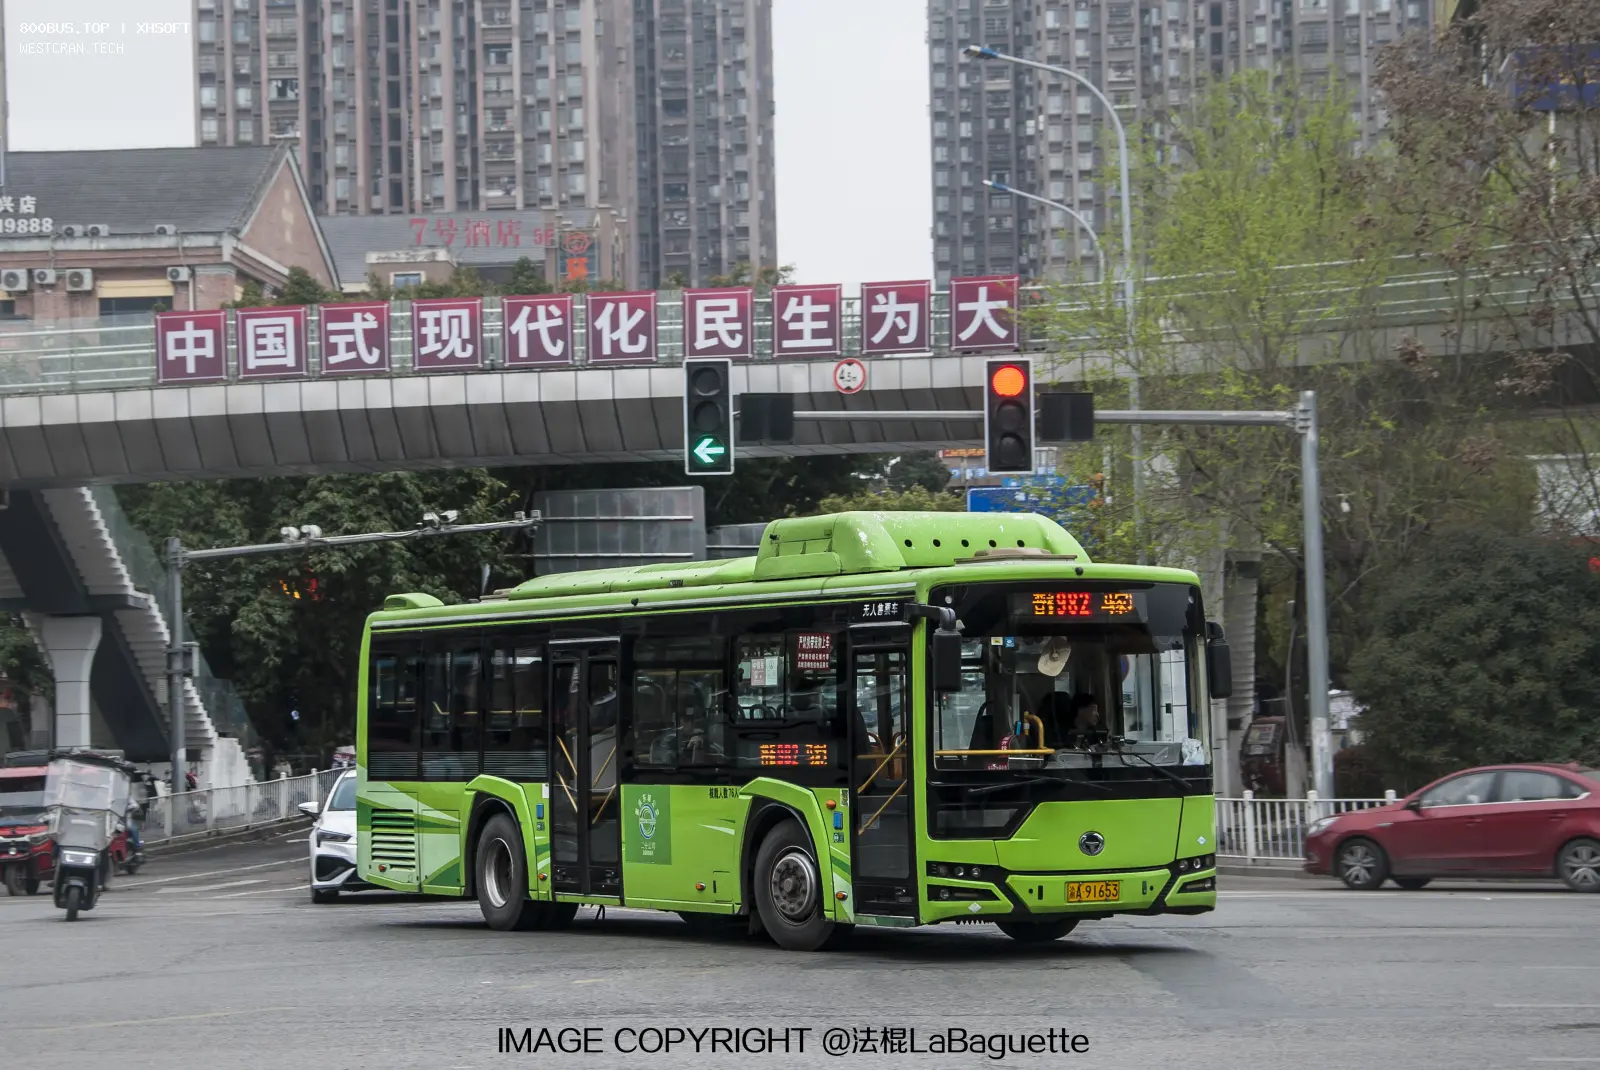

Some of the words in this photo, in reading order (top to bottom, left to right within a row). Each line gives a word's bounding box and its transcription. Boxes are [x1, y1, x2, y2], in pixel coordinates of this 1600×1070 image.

[409, 217, 522, 247] 7号酒店
[165, 286, 1009, 374] 中国式现代化民生为大
[862, 602, 898, 617] 无人售票车
